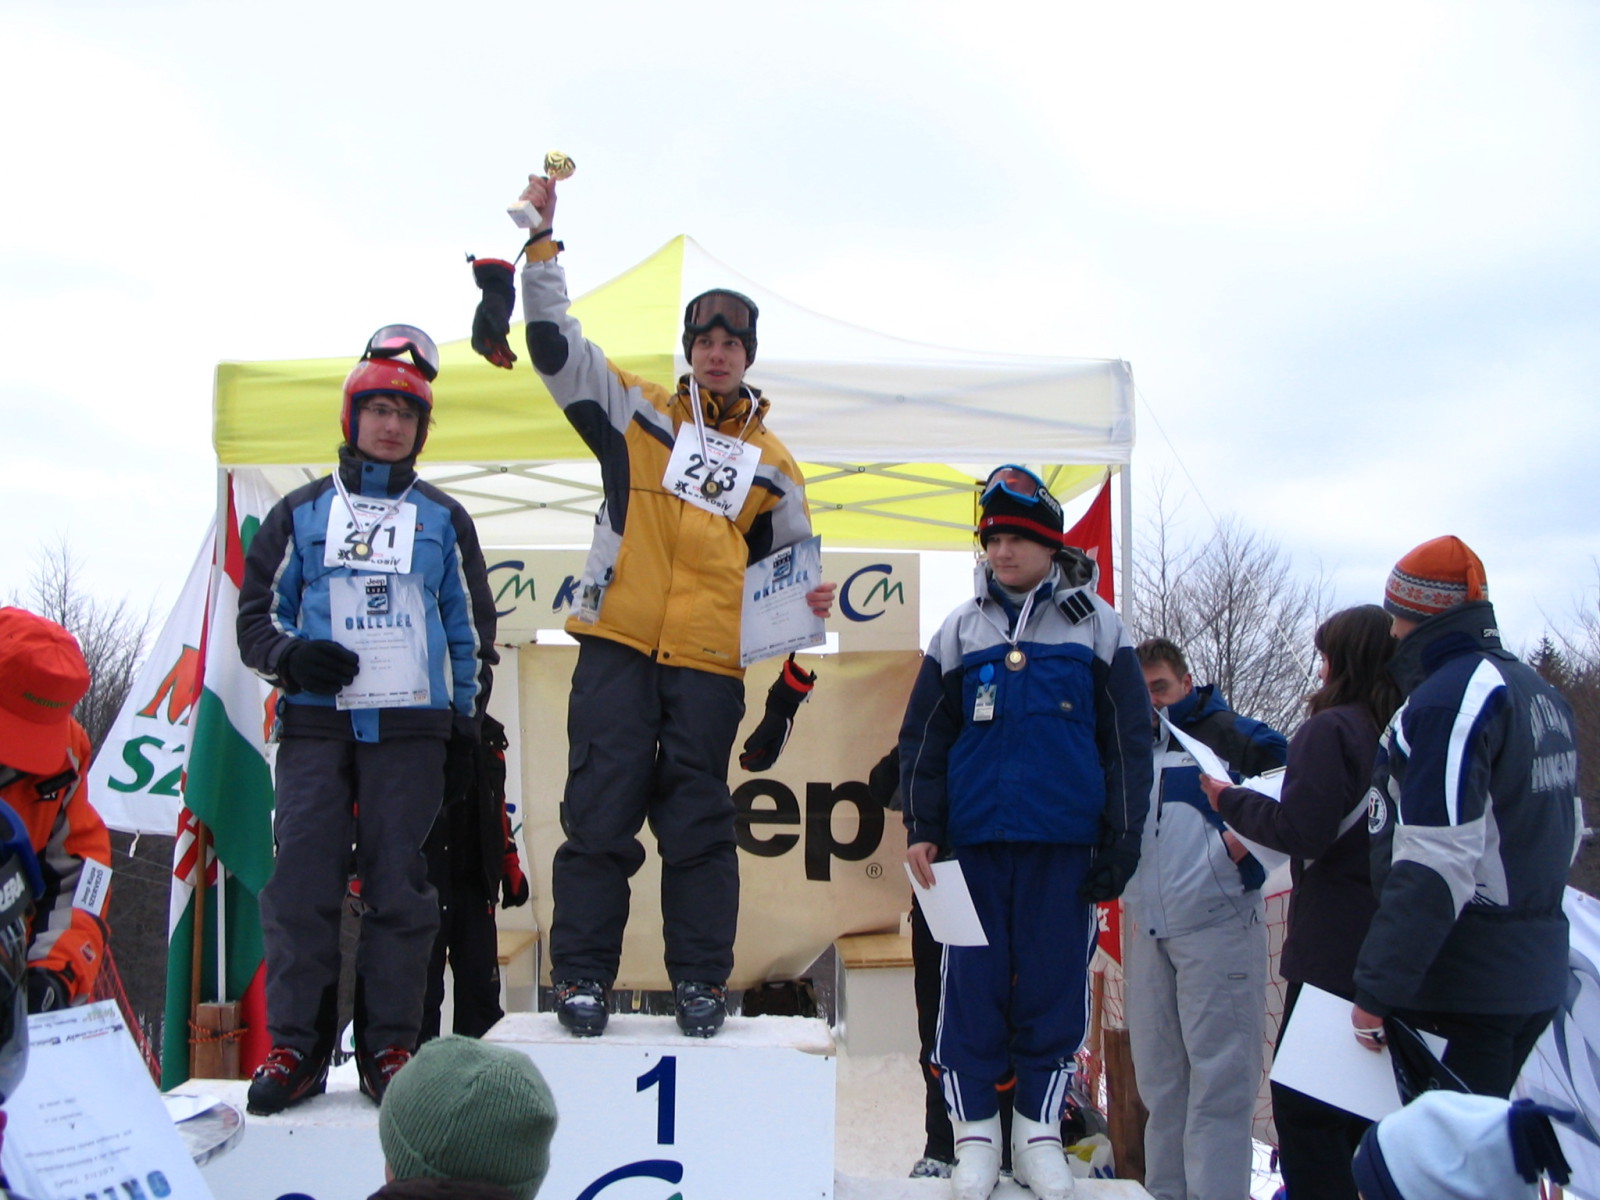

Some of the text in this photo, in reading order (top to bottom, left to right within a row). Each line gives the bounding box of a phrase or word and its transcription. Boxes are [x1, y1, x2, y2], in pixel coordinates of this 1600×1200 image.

[684, 454, 738, 492] 273
[344, 521, 397, 549] 271
[552, 575, 582, 613] K
[733, 778, 885, 882] ep
[636, 1055, 677, 1145] 1
